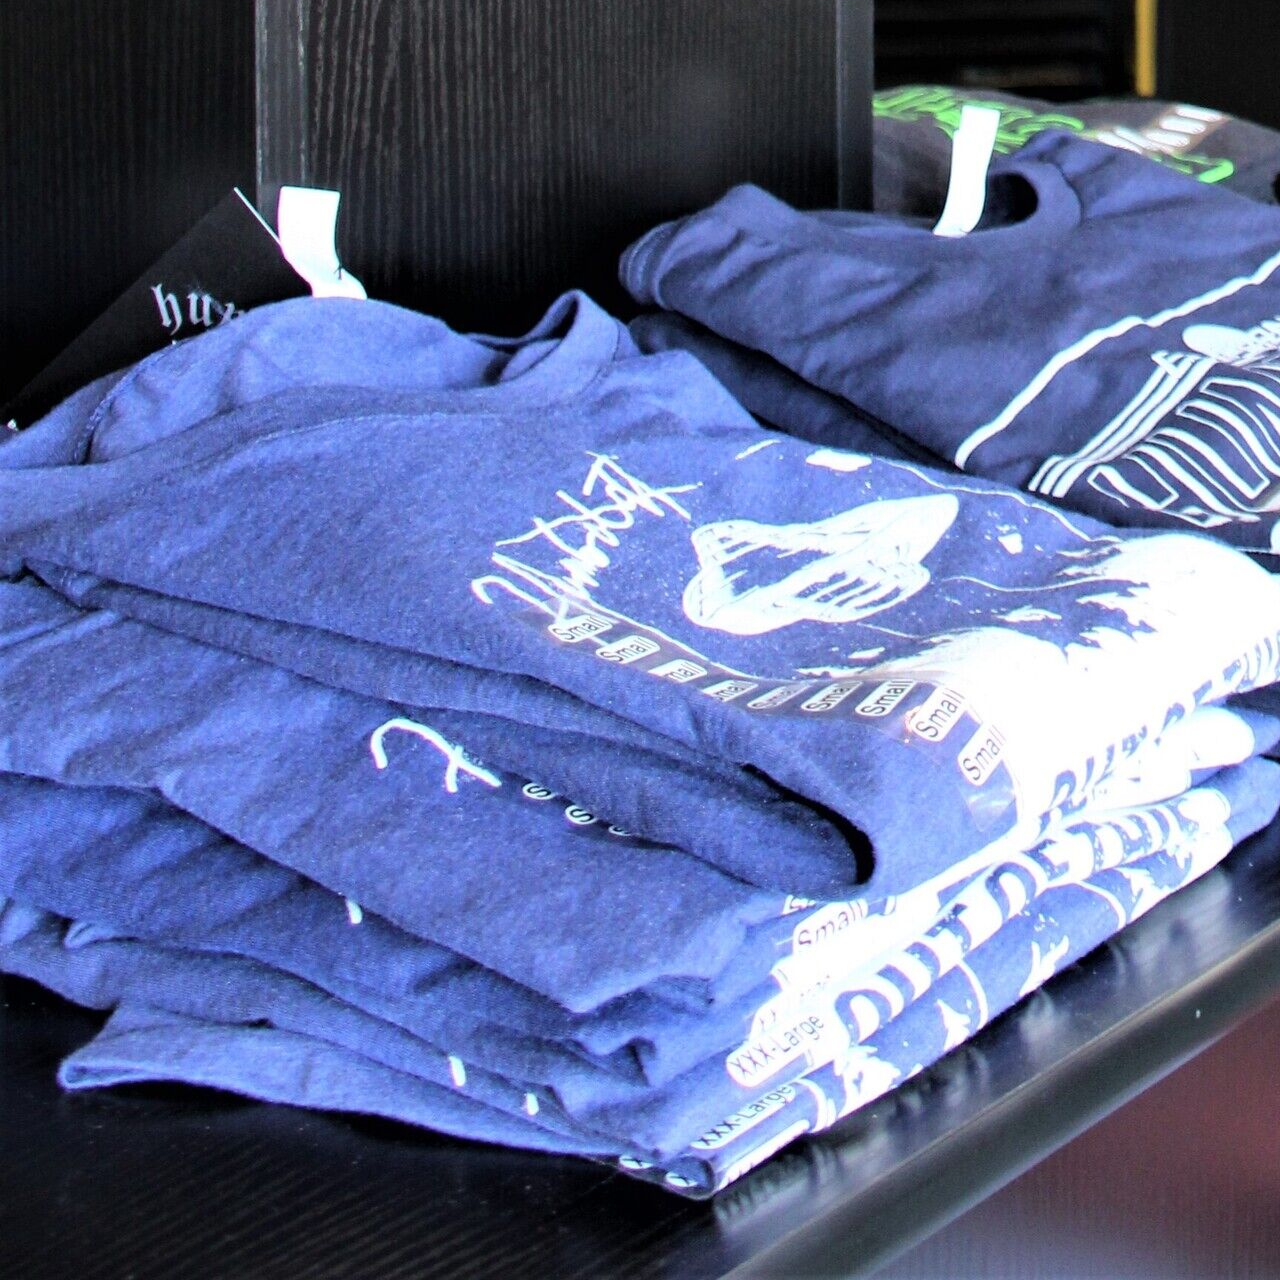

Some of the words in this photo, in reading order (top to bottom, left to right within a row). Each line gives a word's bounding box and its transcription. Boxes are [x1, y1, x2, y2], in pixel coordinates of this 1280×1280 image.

[551, 613, 611, 641] Small
[599, 636, 658, 663] Small
[662, 659, 702, 682] mall
[862, 678, 914, 715] Small
[915, 687, 966, 739] Small
[962, 724, 1007, 781] Small
[730, 1015, 825, 1080] XXX-Large
